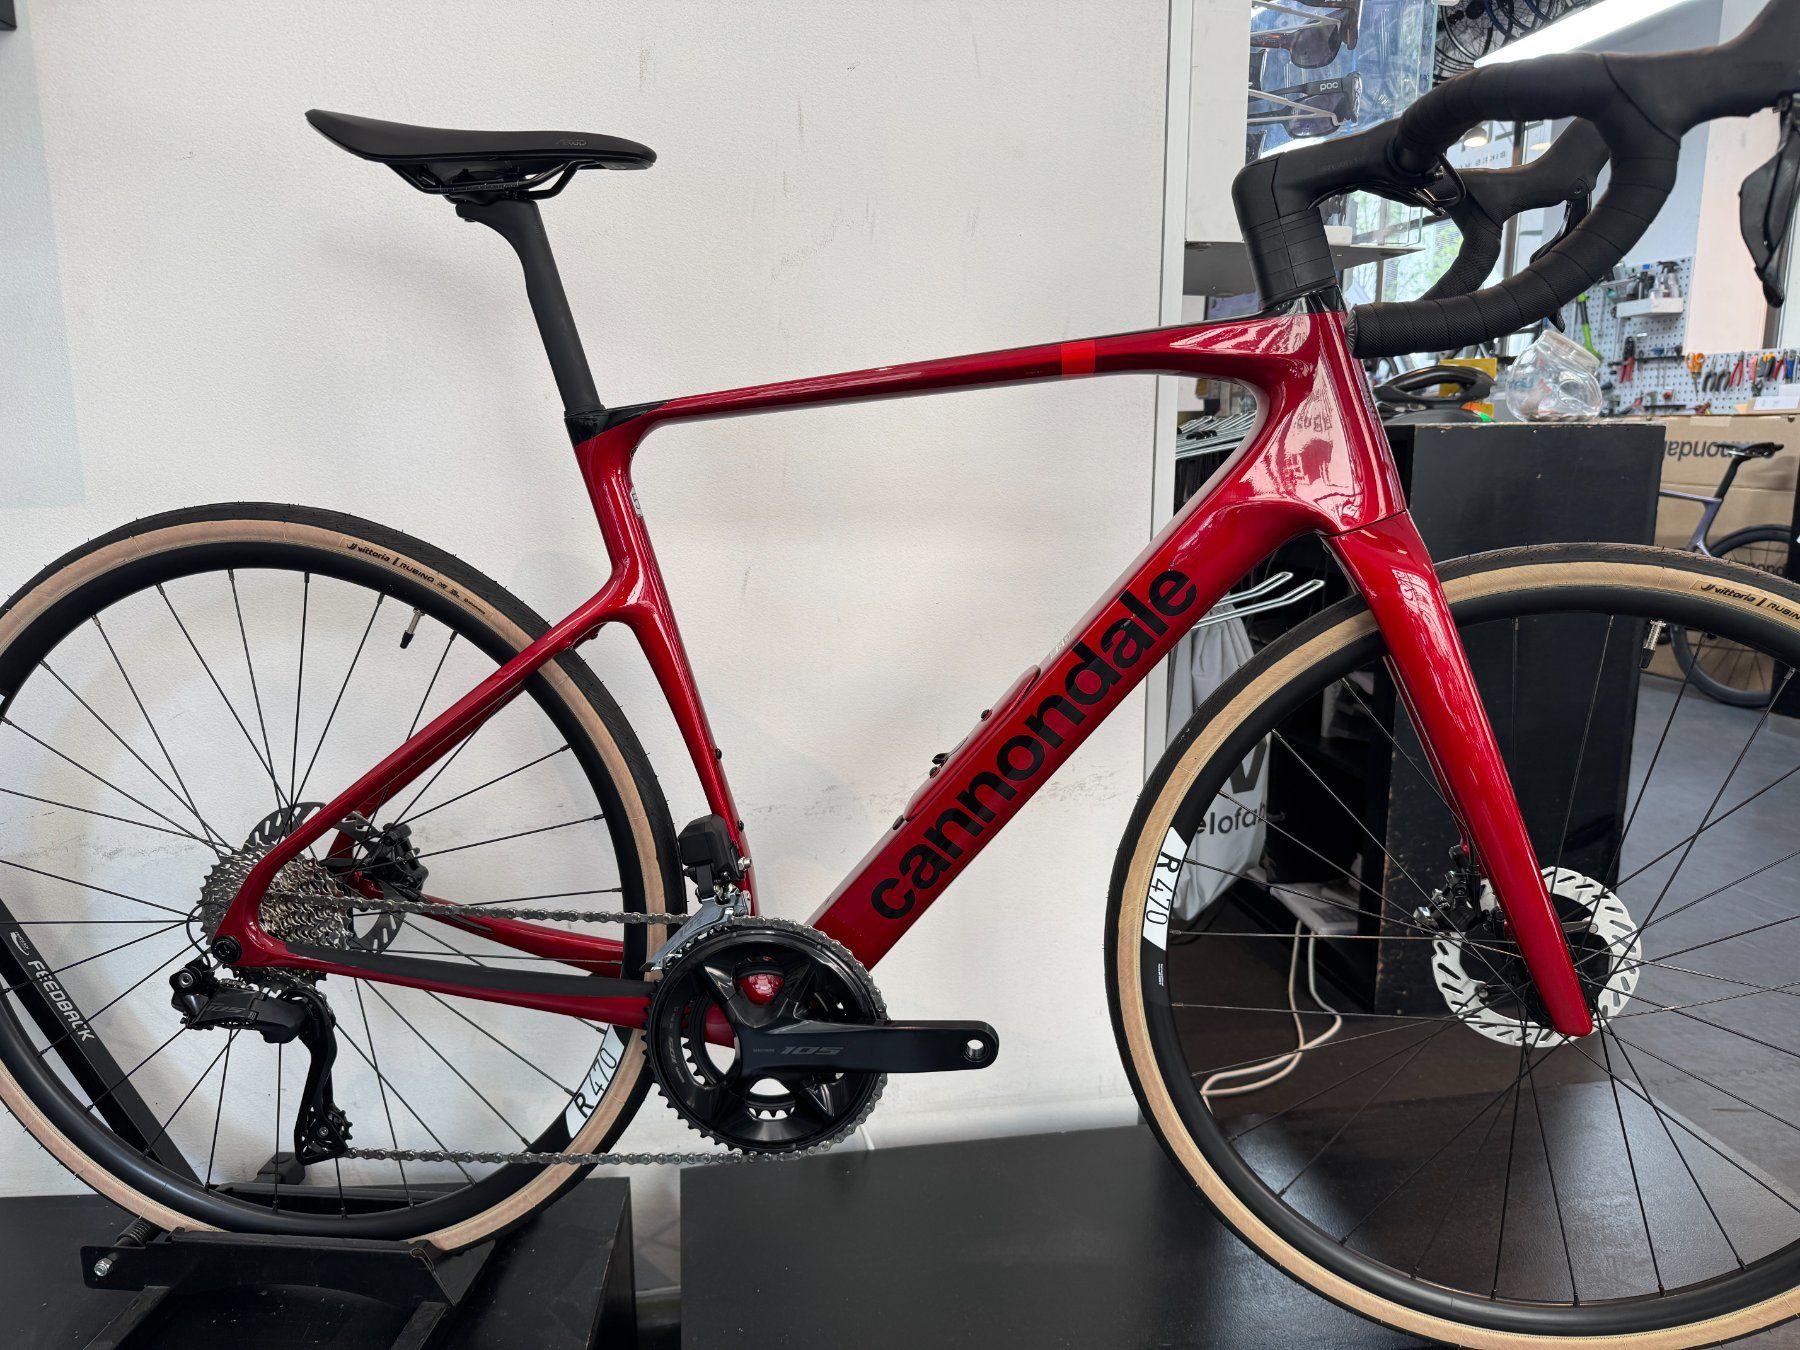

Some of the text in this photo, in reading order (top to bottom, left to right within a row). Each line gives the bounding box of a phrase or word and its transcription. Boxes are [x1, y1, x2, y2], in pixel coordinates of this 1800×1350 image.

[358, 546, 434, 583] vittoria RUBINO
[1715, 587, 1756, 602] vittoria
[870, 569, 1198, 920] cannondale
[1145, 851, 1182, 926] R 470
[27, 960, 96, 1042] FEEDBACK
[574, 1047, 618, 1119] R 470
[780, 1046, 845, 1055] 105
